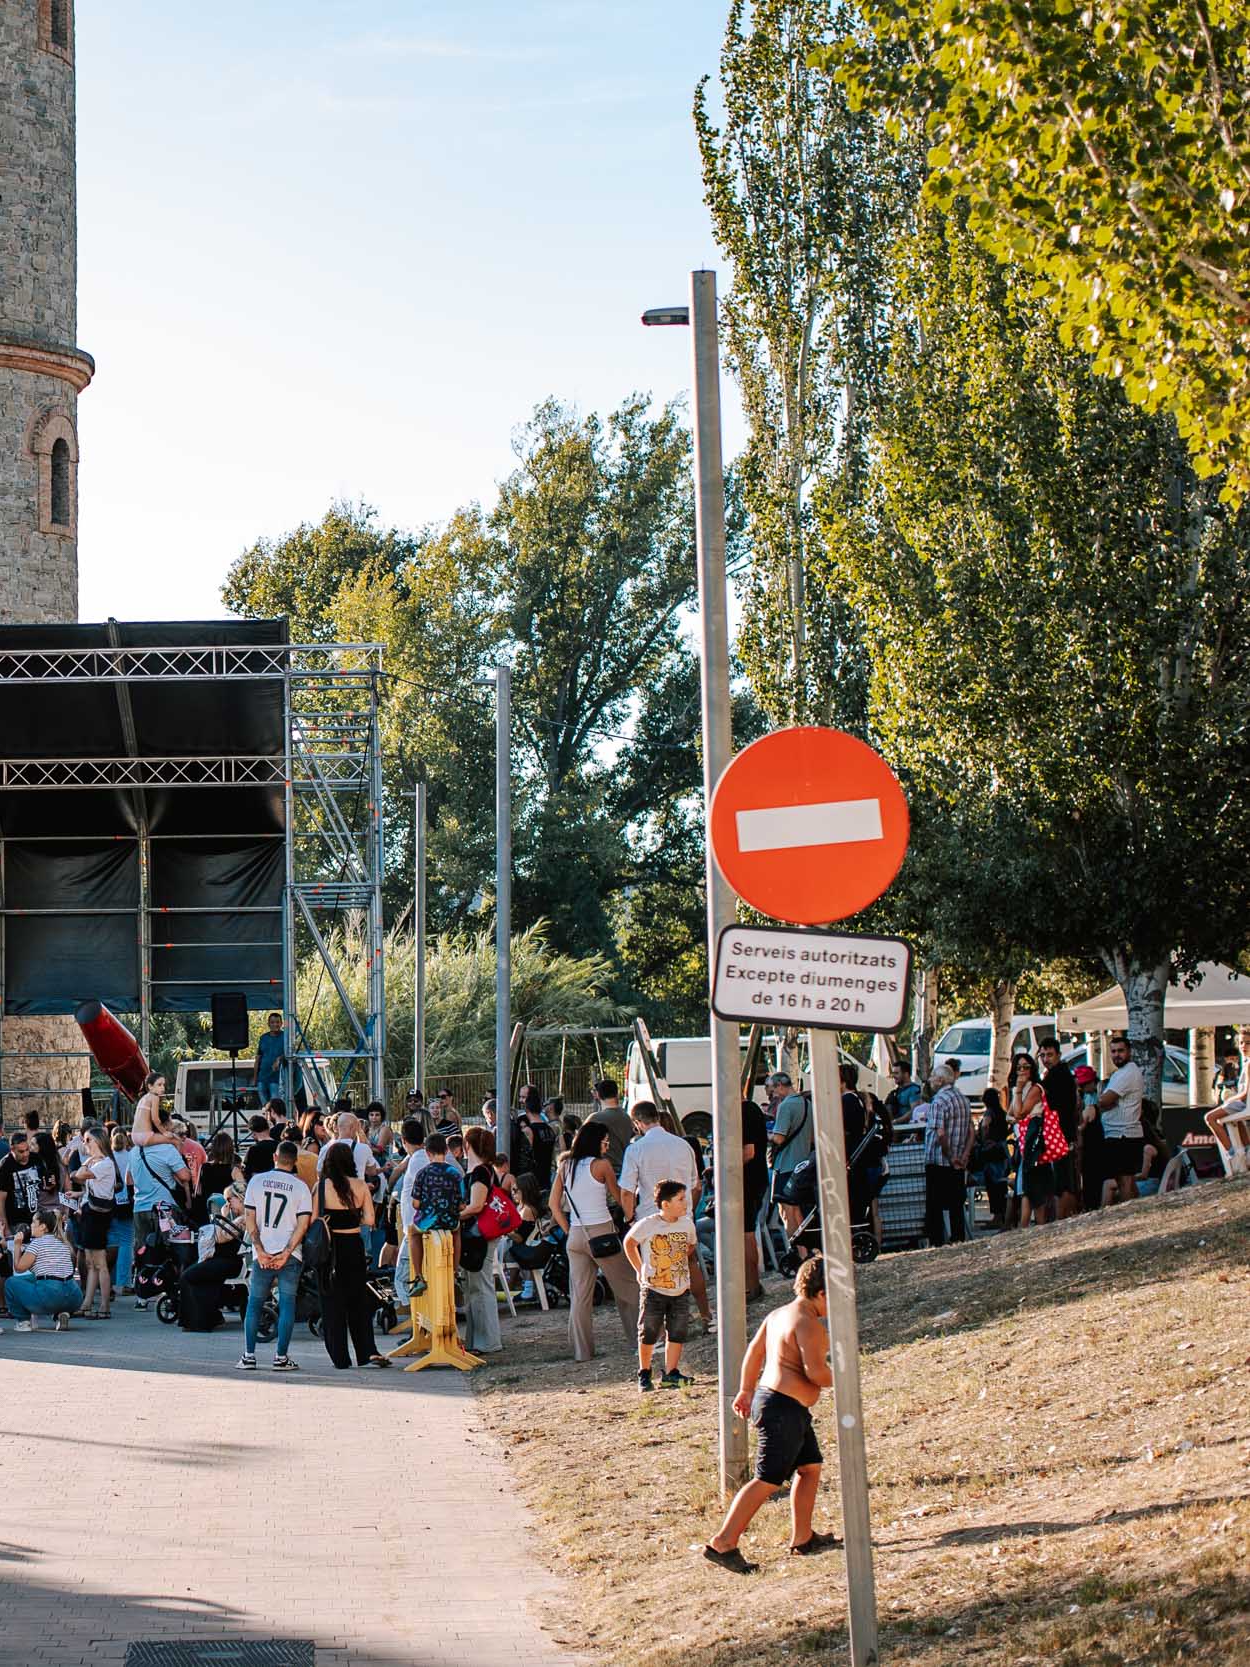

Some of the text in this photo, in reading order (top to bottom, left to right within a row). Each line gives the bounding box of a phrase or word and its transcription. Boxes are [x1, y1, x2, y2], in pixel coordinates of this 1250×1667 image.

[731, 941, 898, 969] Serveis autoritzats
[725, 964, 898, 994] Excepte diumenges
[751, 991, 865, 1013] de 16 h a 20 h
[262, 1179, 294, 1192] CUCURELLA
[264, 1190, 288, 1229] 17
